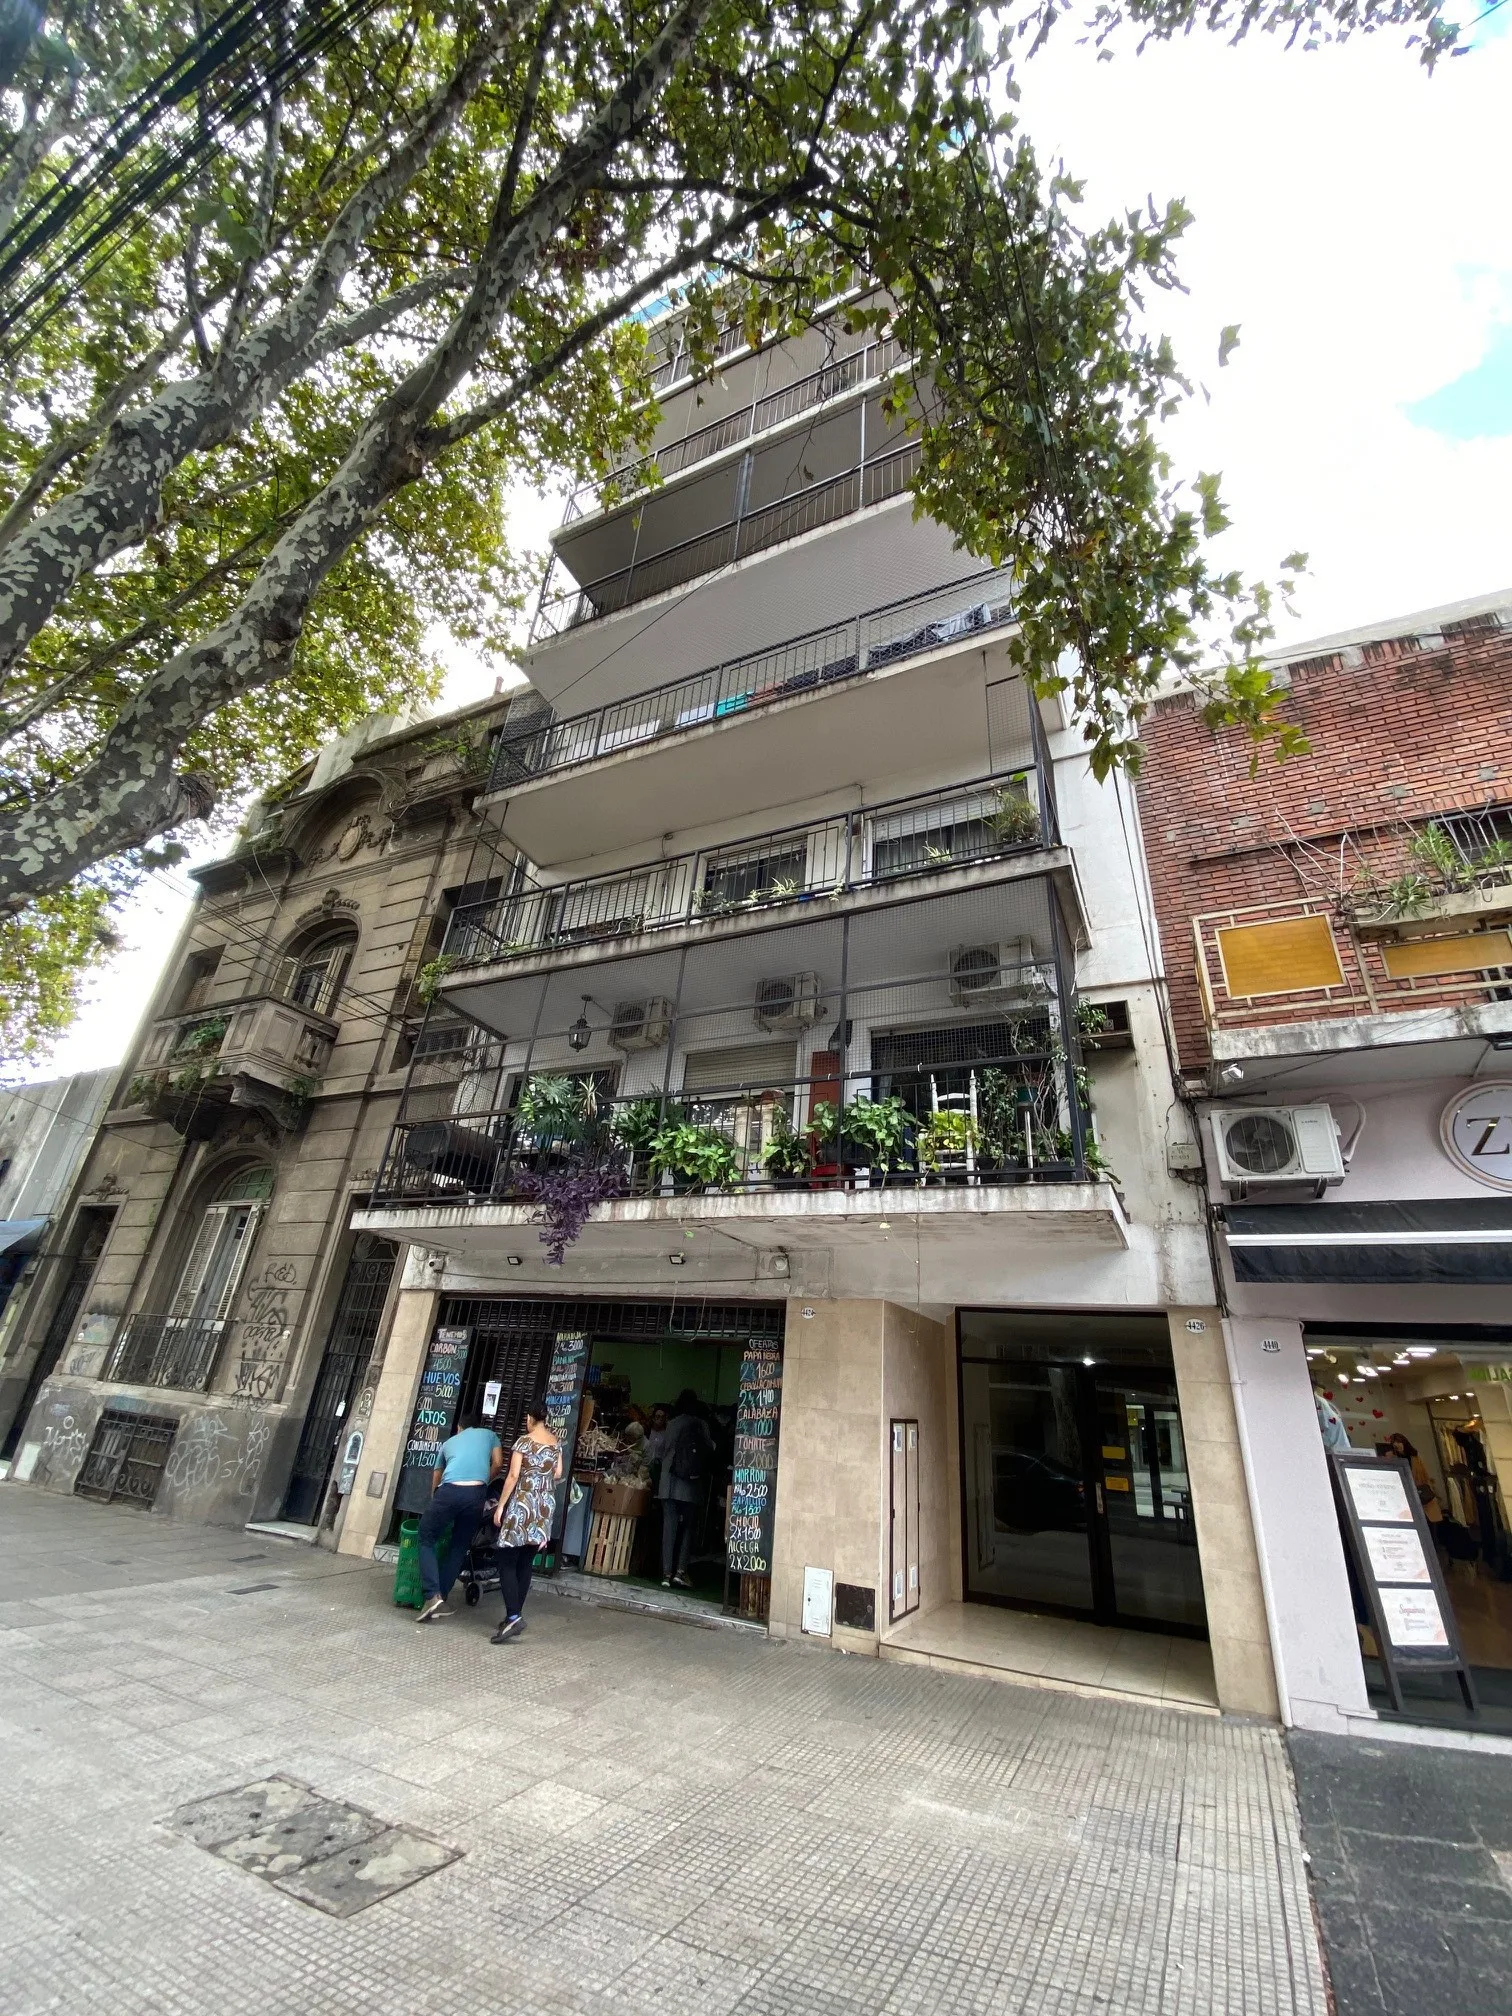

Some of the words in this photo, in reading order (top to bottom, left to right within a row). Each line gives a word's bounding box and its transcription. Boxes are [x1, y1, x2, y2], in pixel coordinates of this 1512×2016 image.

[1187, 1321, 1205, 1330] 4426
[748, 1338, 779, 1349] OFERTAS
[743, 1350, 762, 1361] PAPA
[422, 1370, 461, 1386] HUEVOS
[416, 1409, 447, 1426] AJOS
[736, 1406, 778, 1421] CALABAZA
[734, 1468, 767, 1483] MORRON
